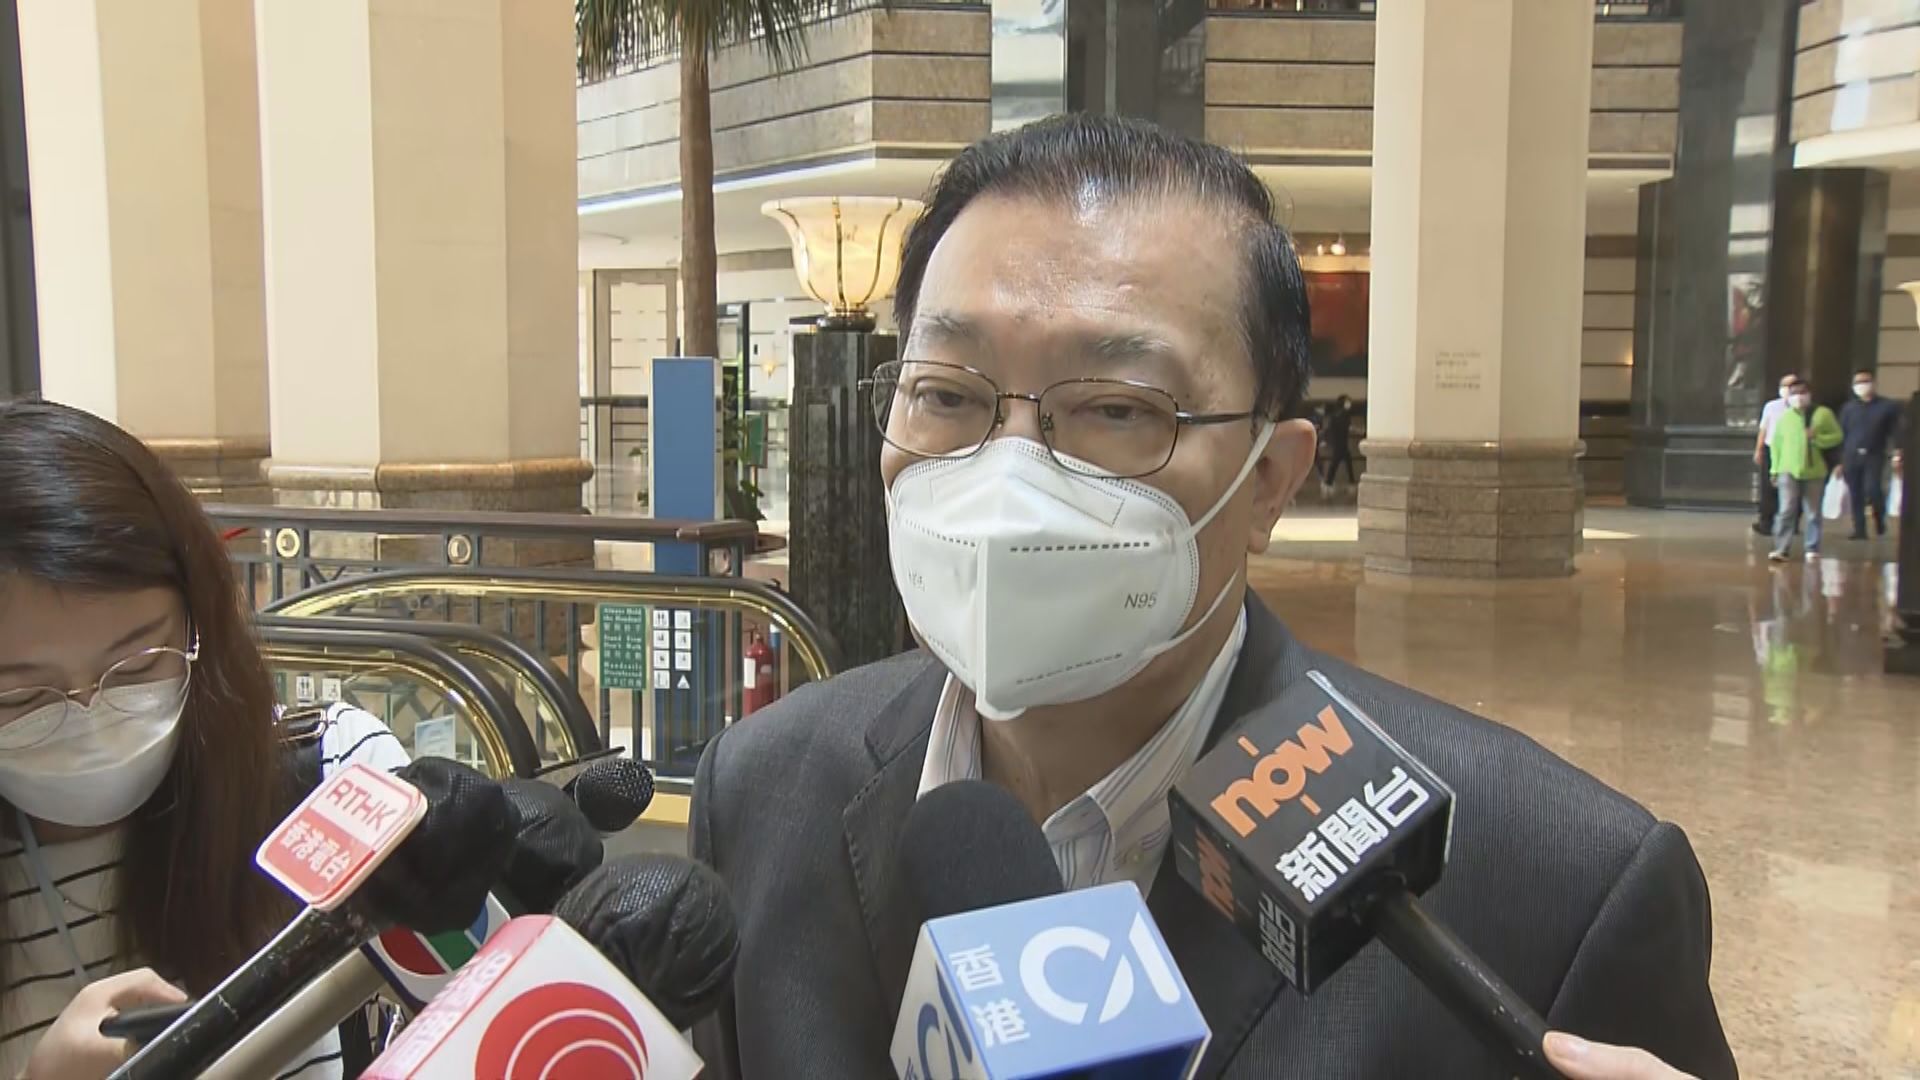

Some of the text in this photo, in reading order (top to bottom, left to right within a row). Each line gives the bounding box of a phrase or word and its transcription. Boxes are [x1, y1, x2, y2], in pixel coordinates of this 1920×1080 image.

[1124, 592, 1158, 609] N95
[326, 778, 397, 832] RTHK
[1210, 703, 1354, 839] now
[279, 820, 351, 882] 香港電台
[1274, 766, 1430, 903] 新聞台
[948, 943, 1032, 1049] 香港
